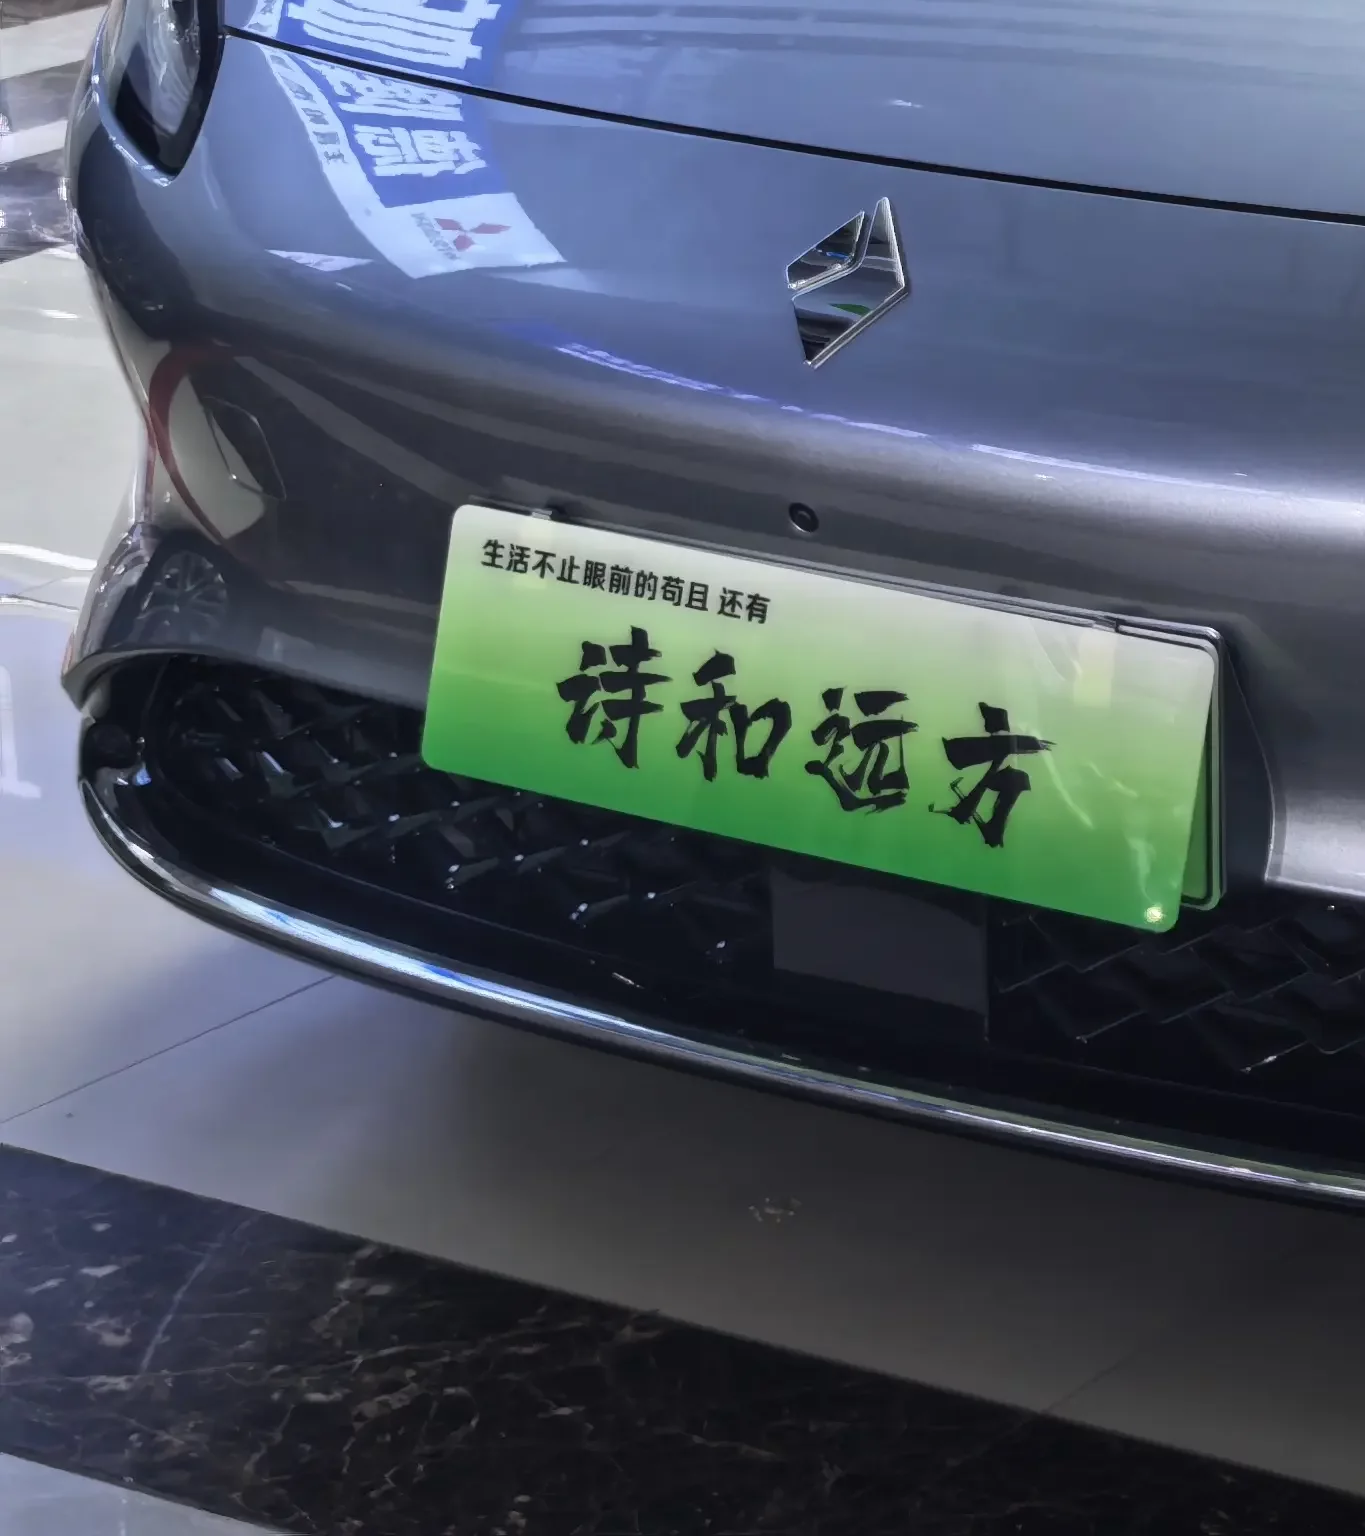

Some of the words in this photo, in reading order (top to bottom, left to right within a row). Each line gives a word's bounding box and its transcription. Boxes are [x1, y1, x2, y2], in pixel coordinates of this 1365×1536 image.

[481, 539, 710, 612] 生活不止眼前的苟且
[717, 586, 772, 625] 还有
[555, 626, 1058, 848] 诗和远方
